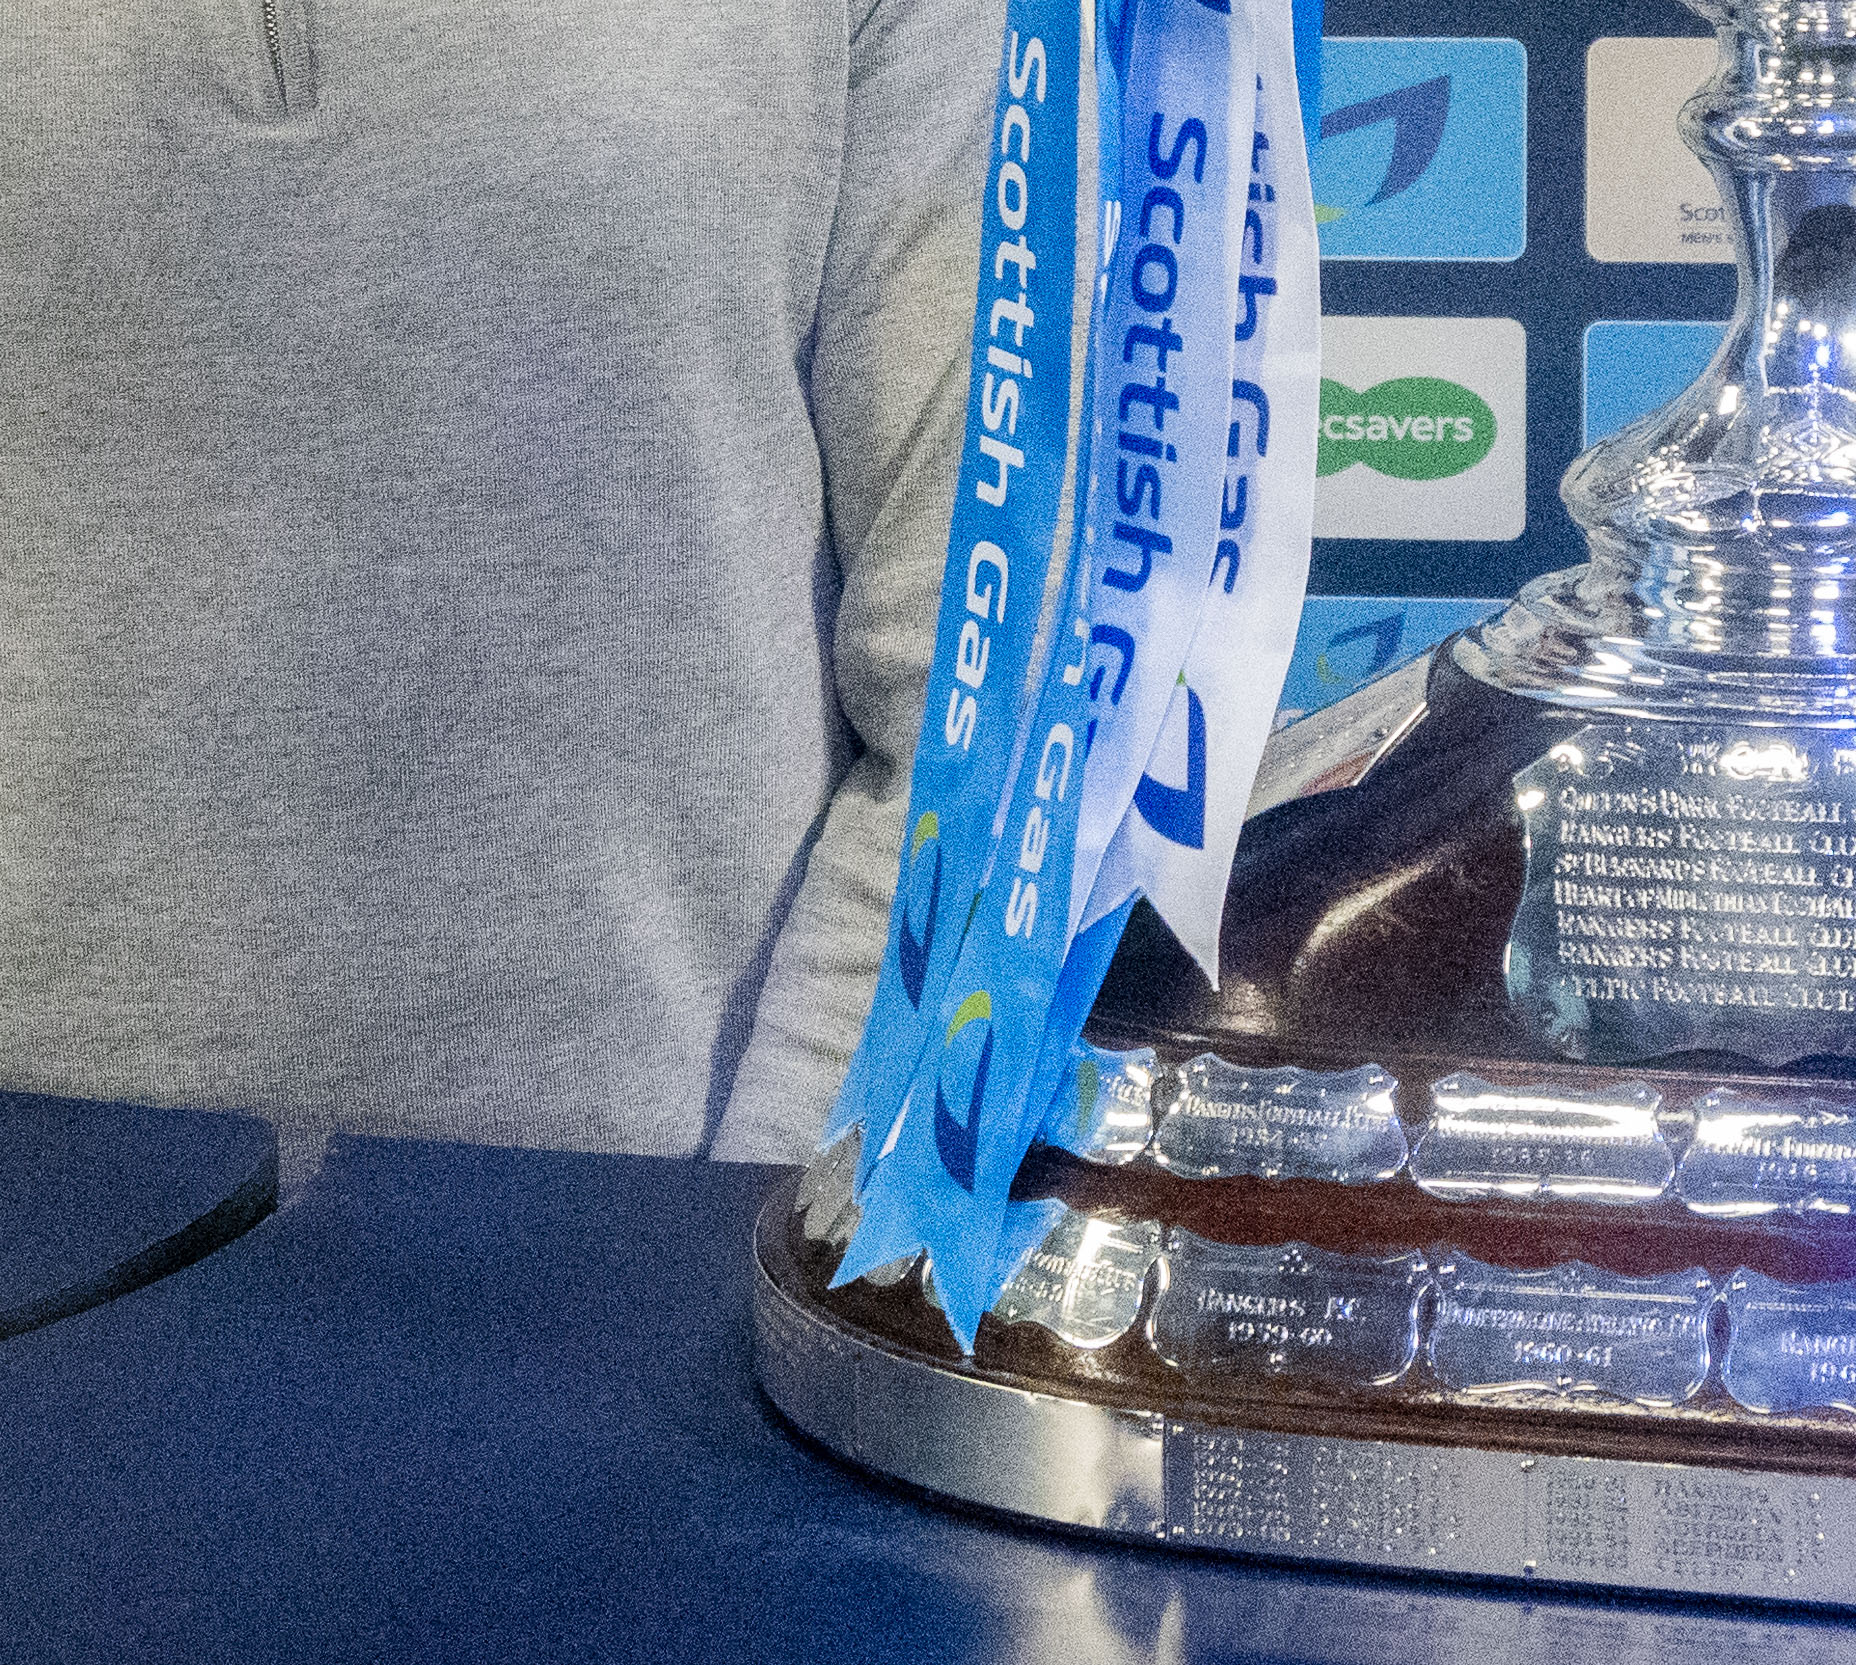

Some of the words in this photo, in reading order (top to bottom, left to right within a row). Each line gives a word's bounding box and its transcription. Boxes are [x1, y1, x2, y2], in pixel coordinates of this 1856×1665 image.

[976, 30, 1048, 510] Scottish
[1679, 202, 1726, 222] Scot
[1098, 111, 1210, 592] Scottish
[1322, 412, 1475, 444] csavers
[945, 549, 1011, 754] Gas
[1005, 720, 1074, 939] Gas
